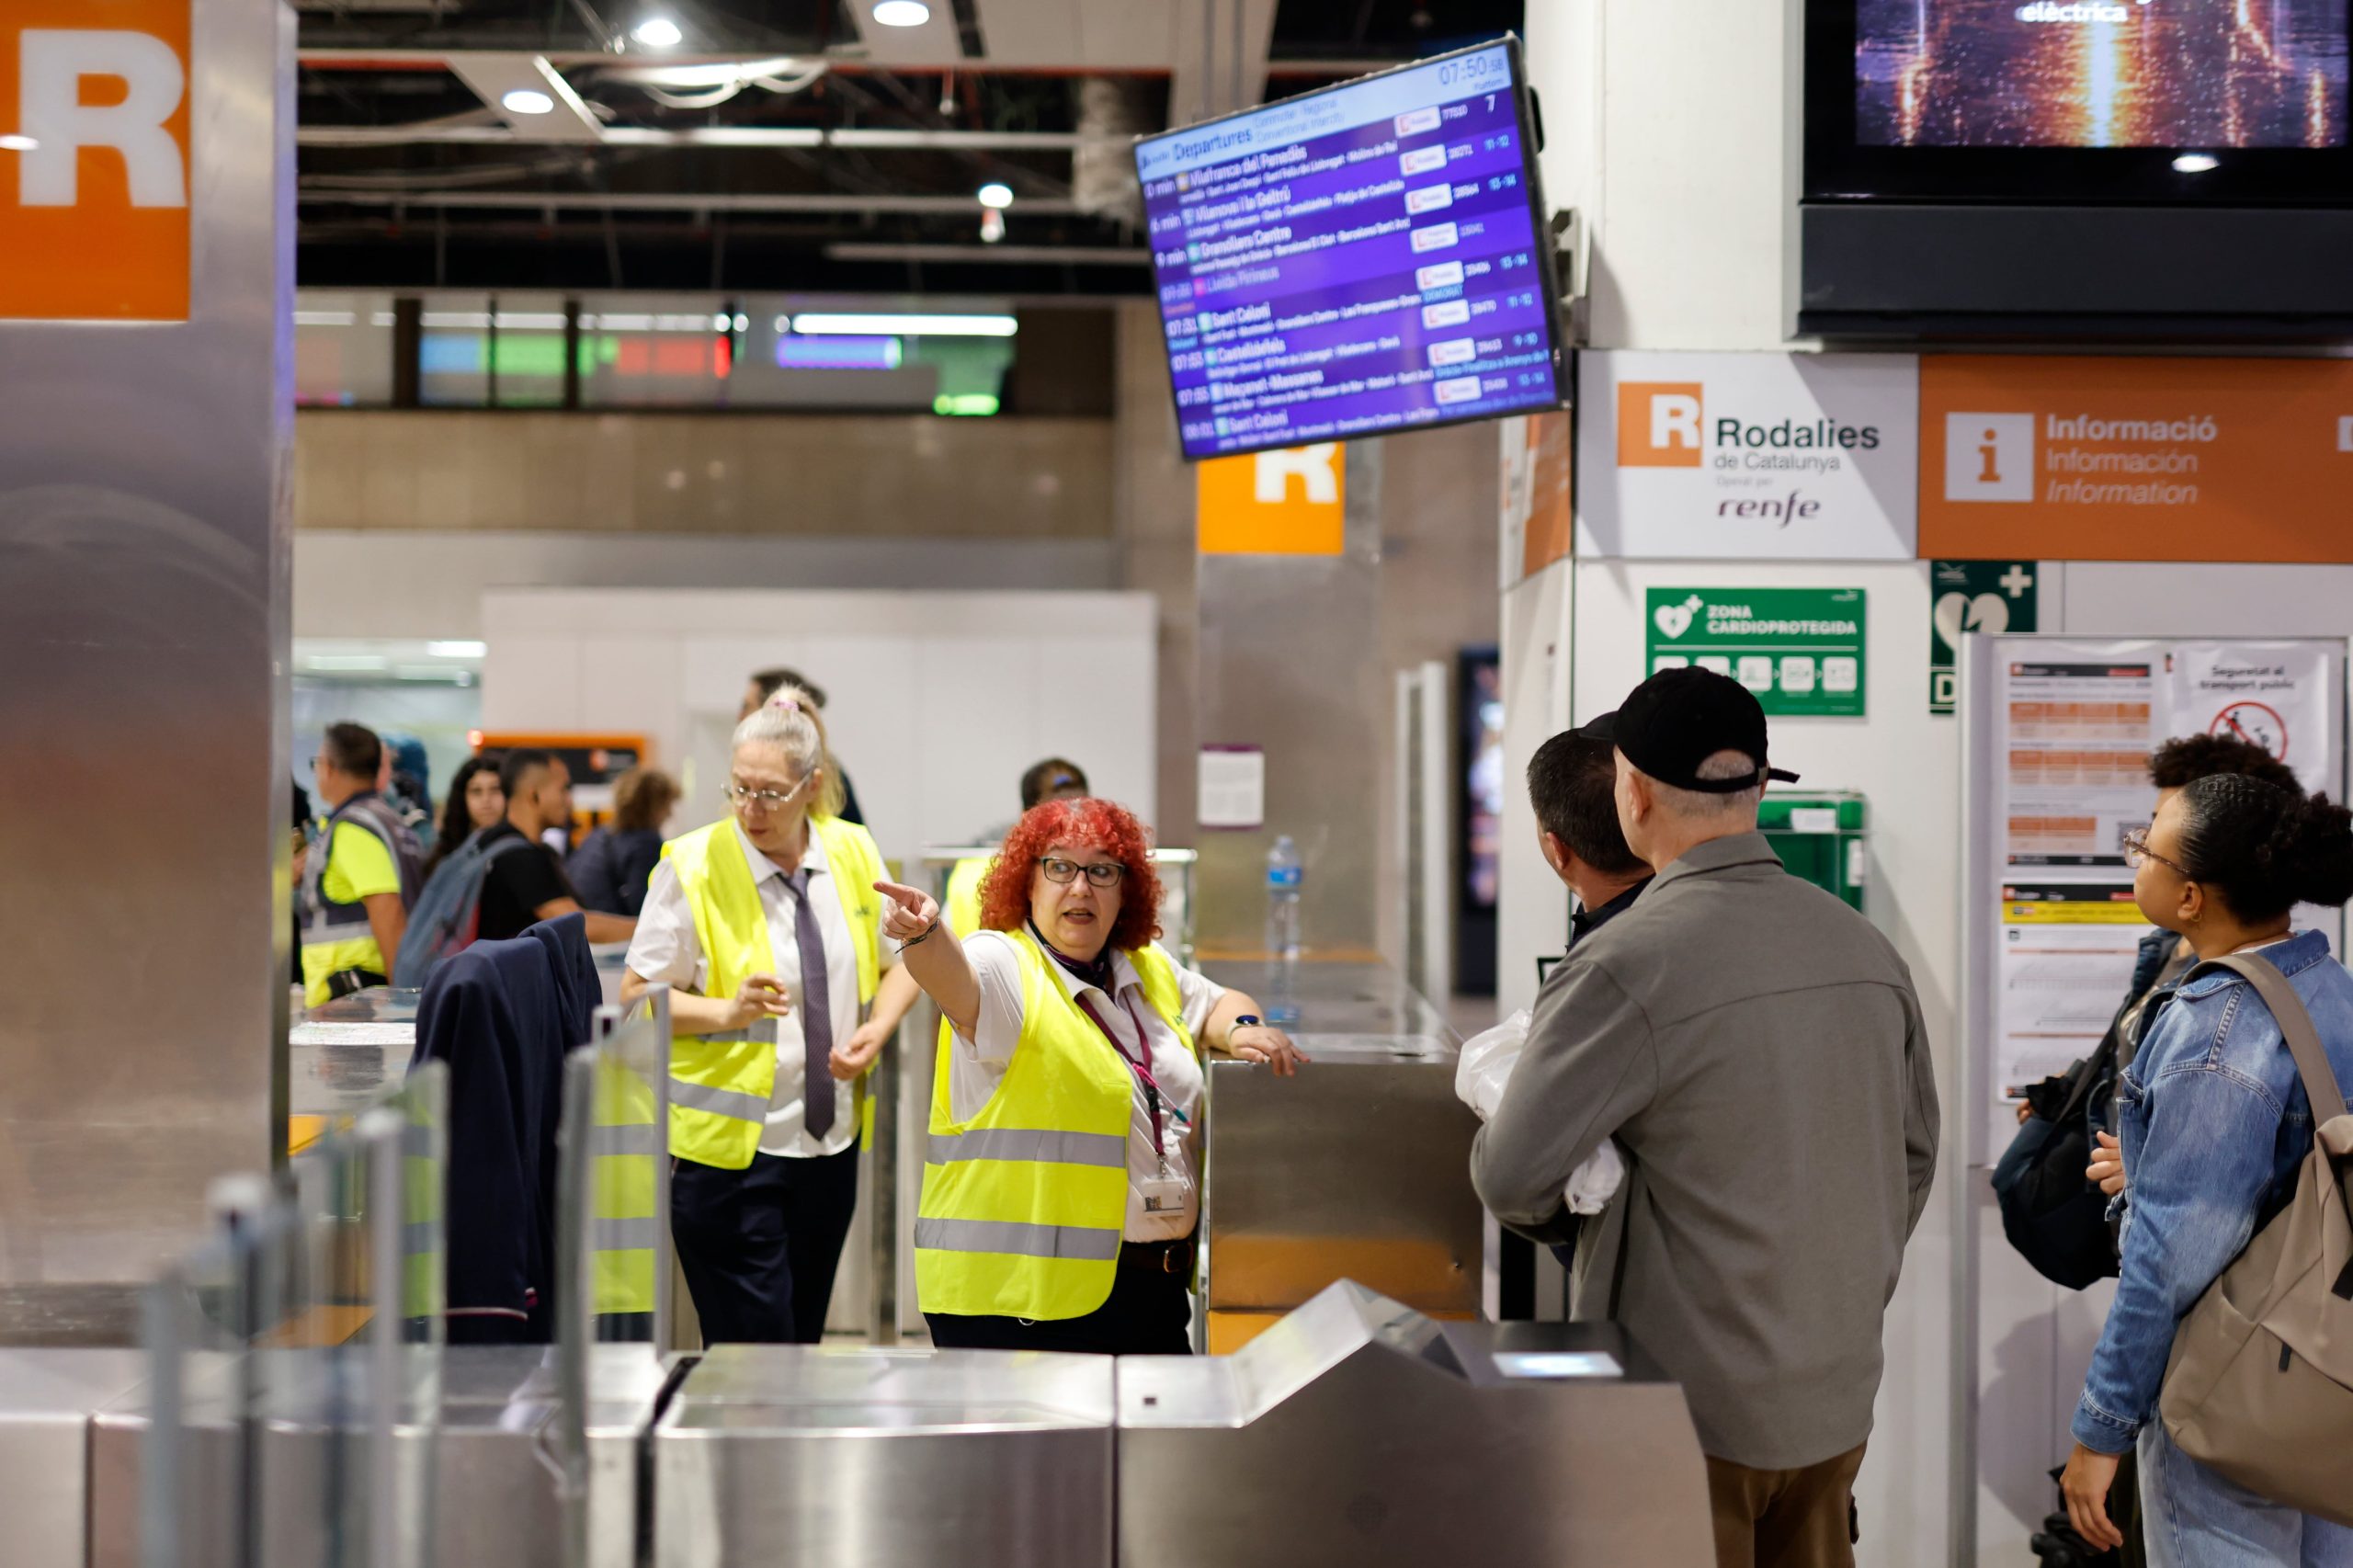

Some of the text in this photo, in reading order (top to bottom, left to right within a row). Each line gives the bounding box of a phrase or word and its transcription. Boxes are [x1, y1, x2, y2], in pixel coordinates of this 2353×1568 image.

[2018, 1, 2128, 22] elèctrica
[1484, 93, 1497, 113] 7
[19, 29, 187, 207] R
[1173, 123, 1253, 164] Departures
[1650, 393, 1700, 449] R
[1716, 418, 1881, 449] Rodalies
[2046, 415, 2218, 442] Informació
[1713, 451, 1842, 476] de Catalunya
[2045, 448, 2199, 474] Información
[2045, 479, 2200, 505] Information
[1717, 488, 1822, 530] renfe
[1707, 604, 1754, 619] ZONA
[1707, 619, 1858, 635] CARDIOPROTEGIDA
[2211, 665, 2270, 678] Seguretat
